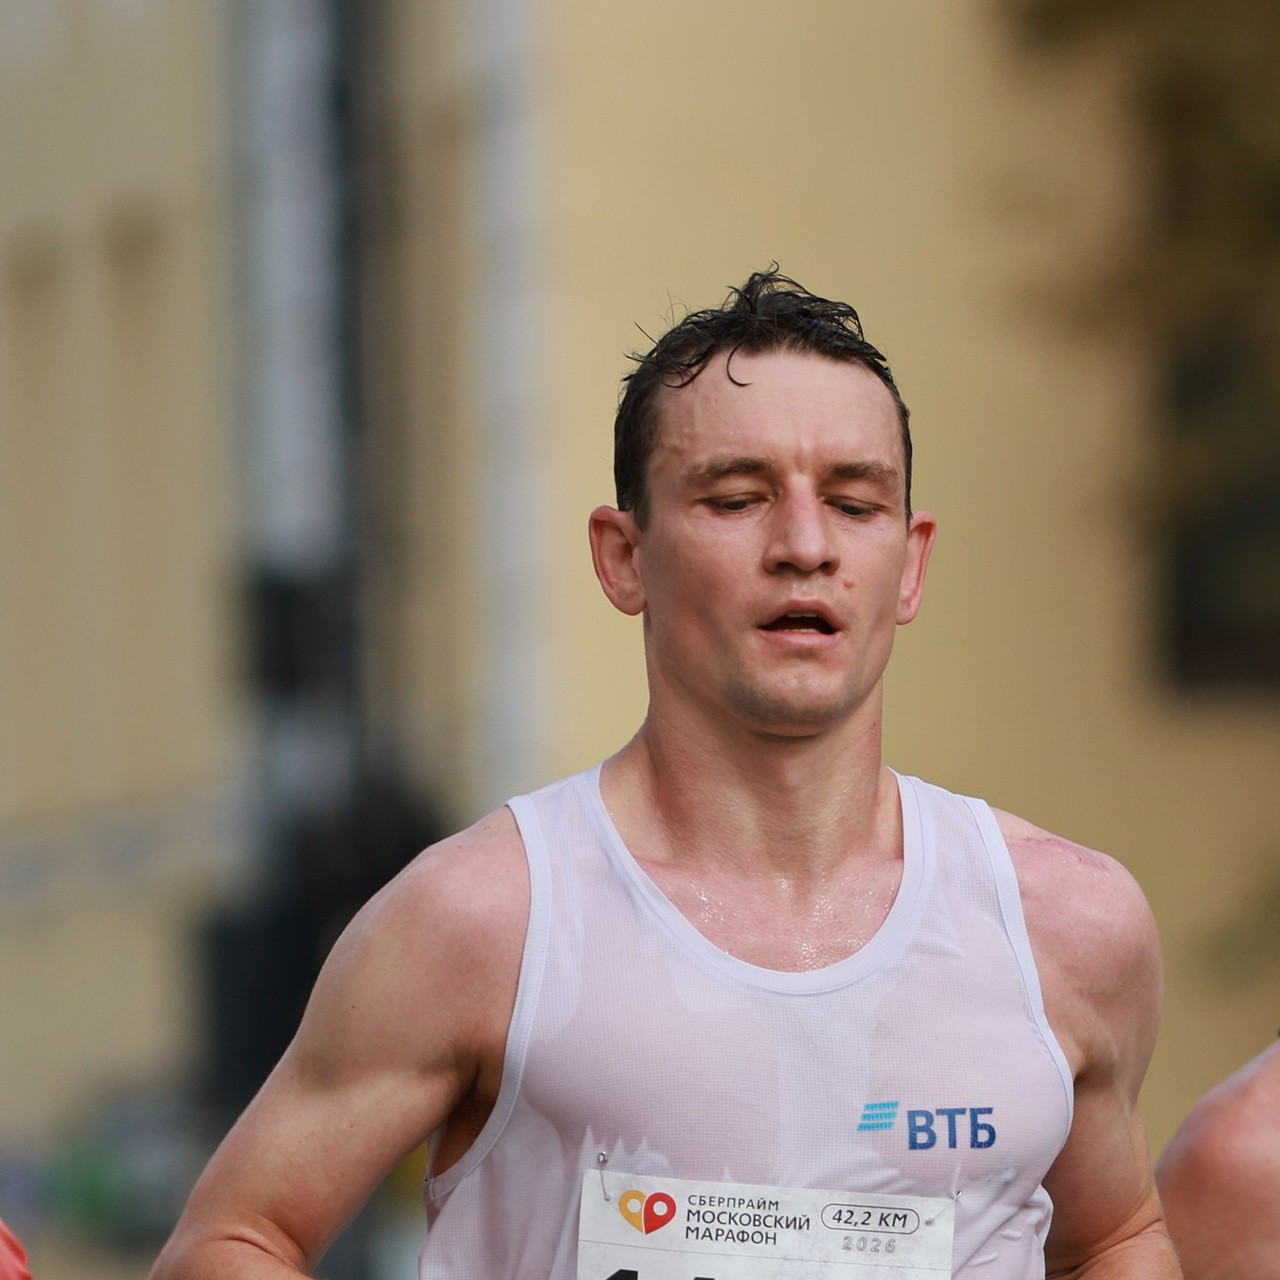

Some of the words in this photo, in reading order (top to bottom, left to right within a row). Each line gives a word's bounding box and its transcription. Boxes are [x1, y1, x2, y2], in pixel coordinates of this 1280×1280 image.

[908, 1107, 997, 1150] ВТБ
[688, 1194, 780, 1211] СБЕРПРАЙМ
[686, 1208, 811, 1231] МОСКОВСКИЙ
[832, 1209, 872, 1227] 42,2
[685, 1226, 777, 1245] МАРАФОН
[842, 1235, 897, 1254] 2026
